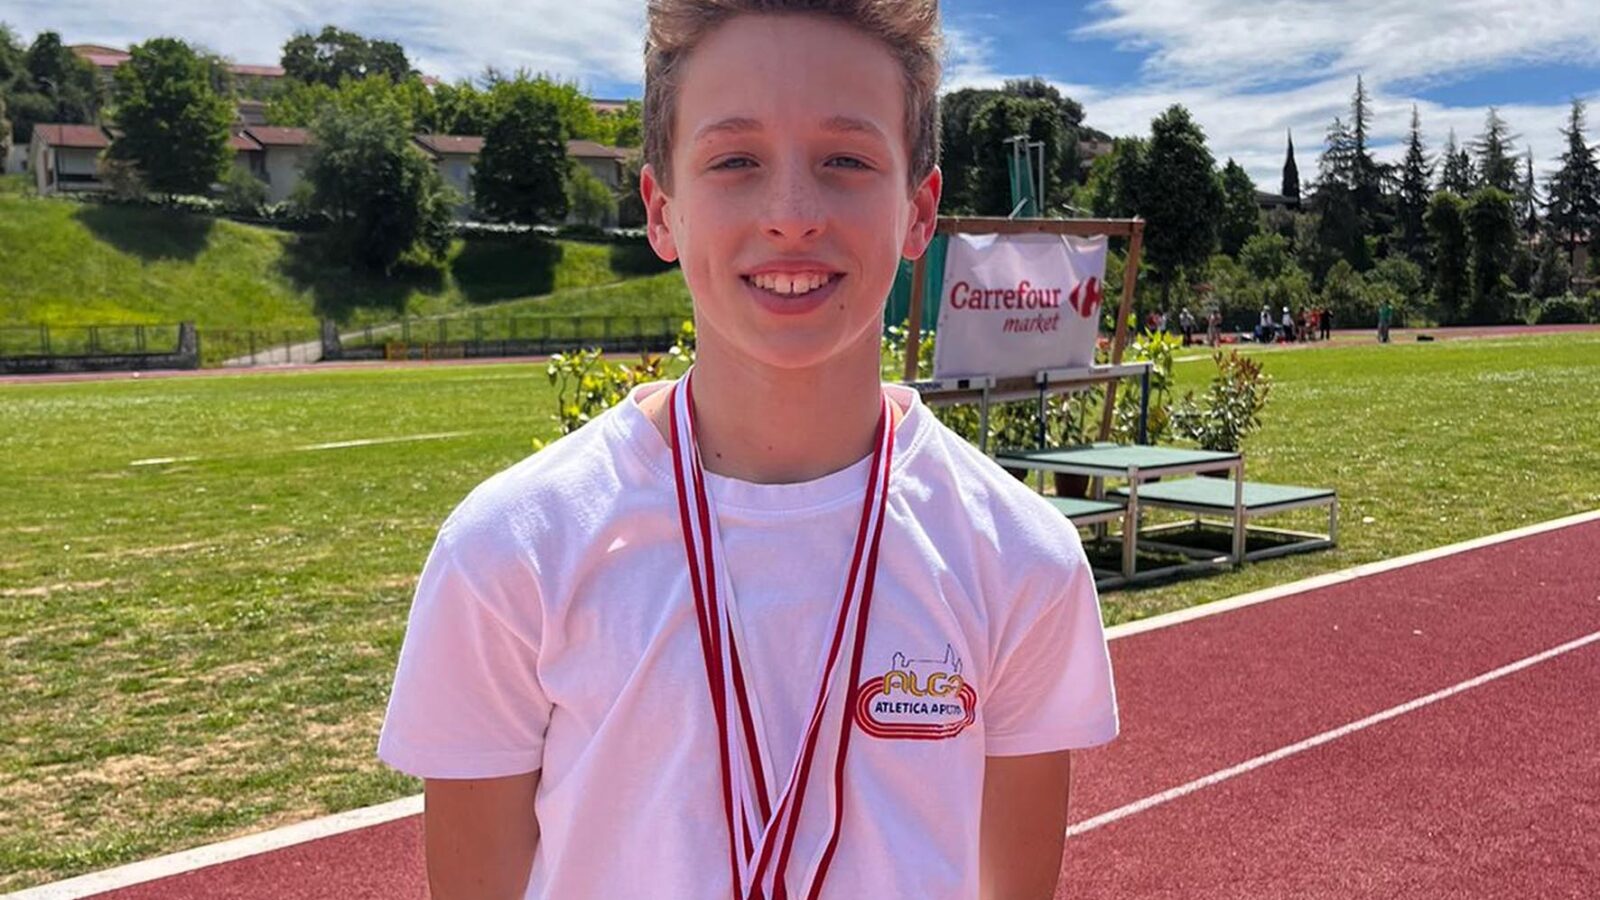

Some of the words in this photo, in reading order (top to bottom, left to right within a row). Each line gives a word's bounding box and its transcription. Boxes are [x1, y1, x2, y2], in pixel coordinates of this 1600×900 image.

[950, 280, 1061, 310] Carrefour
[1003, 314, 1060, 334] market
[875, 702, 928, 714] ATLETICA
